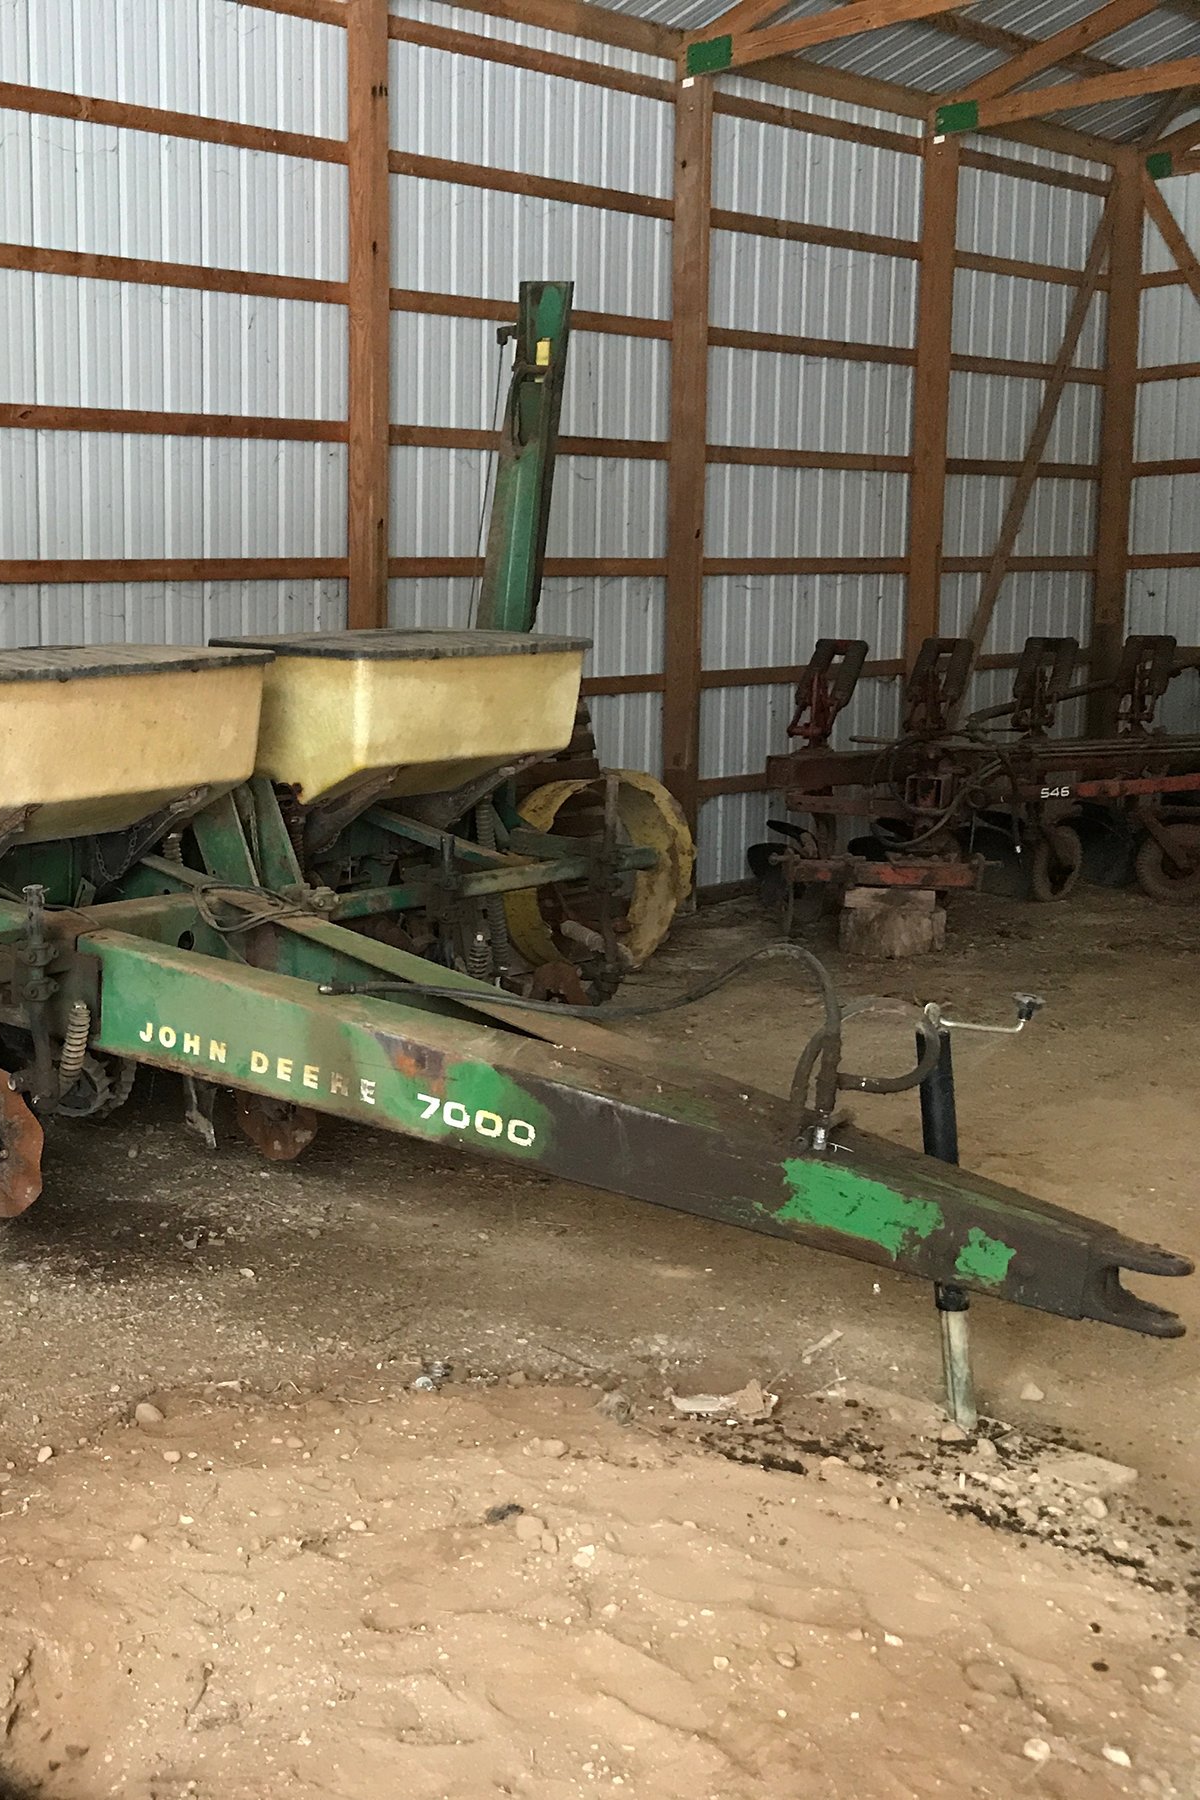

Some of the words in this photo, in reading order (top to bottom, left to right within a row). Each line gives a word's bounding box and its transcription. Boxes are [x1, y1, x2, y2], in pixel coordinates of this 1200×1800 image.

[1040, 786, 1070, 799] 546
[139, 1022, 227, 1064] JOHN
[250, 1050, 376, 1105] DEERE
[416, 1092, 536, 1147] 7000
